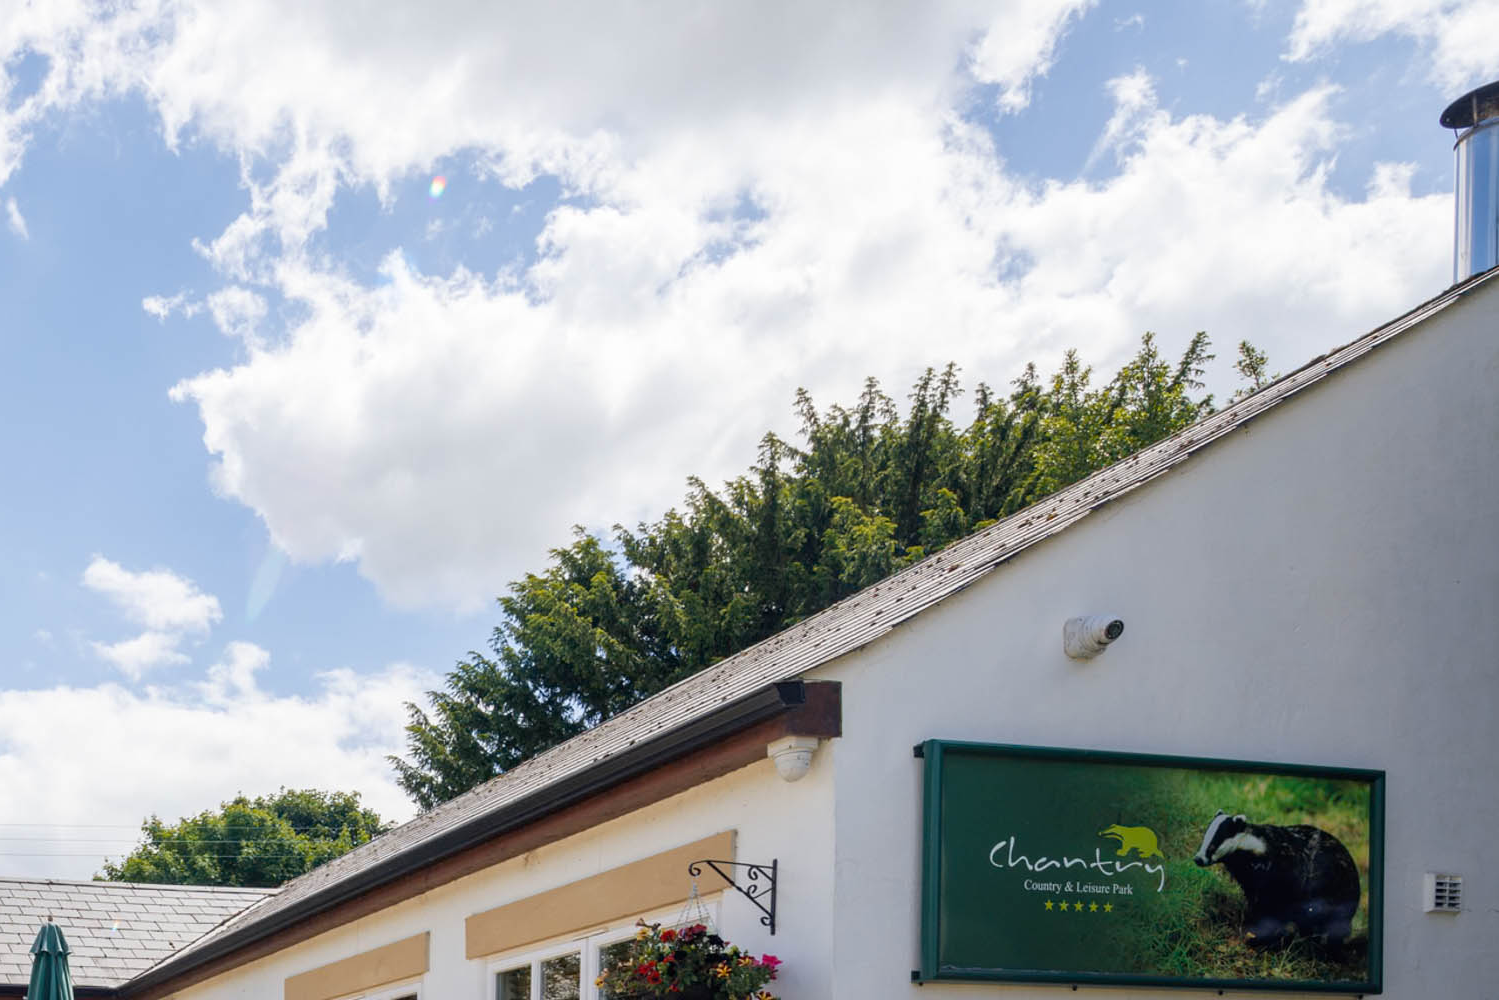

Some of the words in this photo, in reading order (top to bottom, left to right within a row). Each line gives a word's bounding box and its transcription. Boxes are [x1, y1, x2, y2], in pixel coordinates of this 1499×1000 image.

[989, 836, 1165, 893] Chantry
[1024, 879, 1062, 894] Country
[1064, 881, 1074, 893] &
[1076, 881, 1110, 894] Leisure
[1113, 883, 1133, 895] Park
